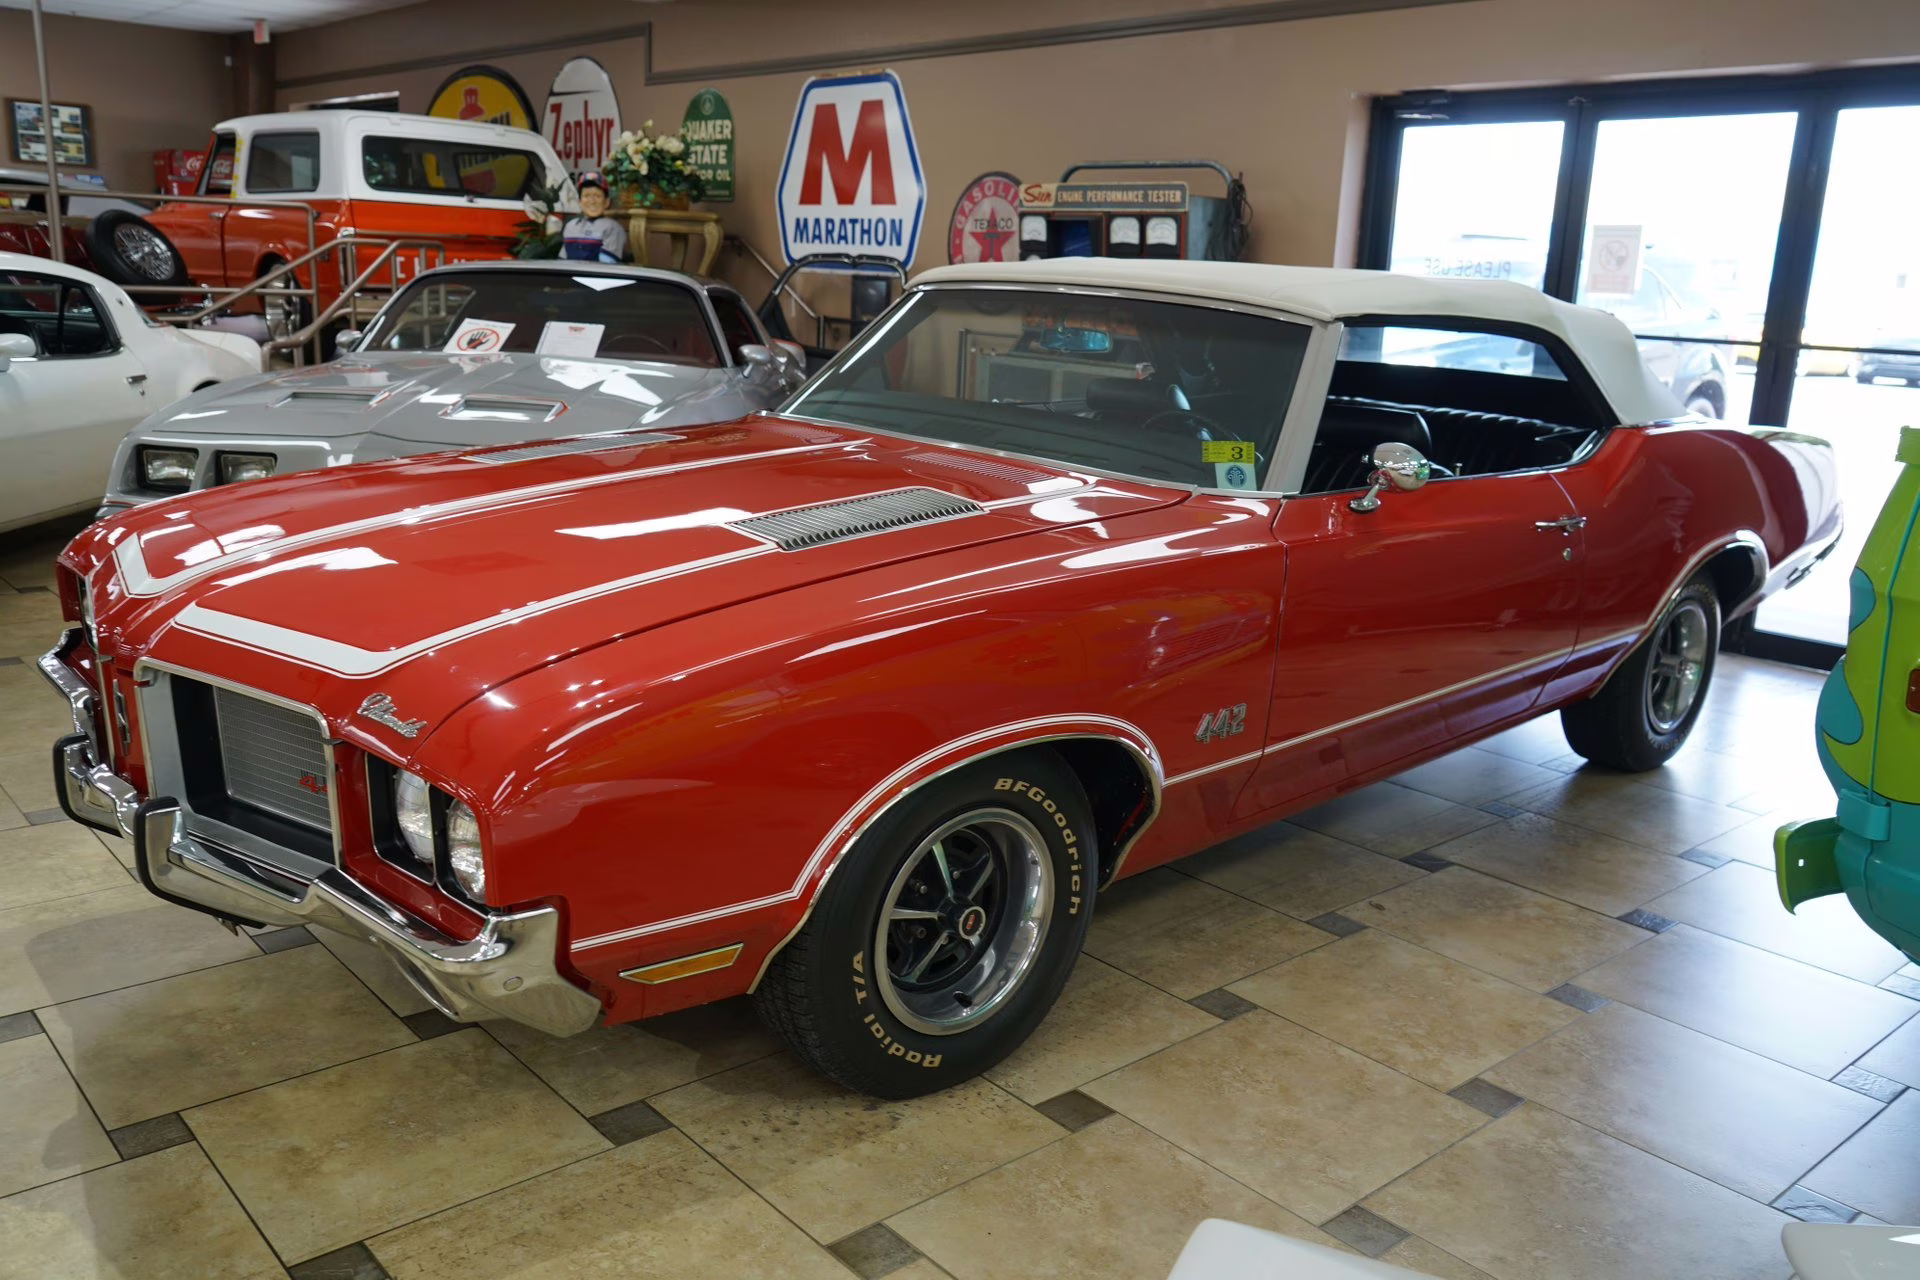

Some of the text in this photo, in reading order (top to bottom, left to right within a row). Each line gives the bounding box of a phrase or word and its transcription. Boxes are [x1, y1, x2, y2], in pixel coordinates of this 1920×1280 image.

[550, 100, 615, 168] Zephyr
[798, 99, 897, 205] M
[715, 169, 731, 181] OIL
[1023, 184, 1053, 204] Sun
[1057, 189, 1182, 203] ENGINE PERFORMANCE TESTER
[793, 217, 903, 246] MARATHON
[973, 217, 1014, 230] TEXACO
[1231, 446, 1244, 460] 3
[1193, 702, 1247, 744] 442
[994, 778, 1082, 914] BFGoodrich
[853, 951, 942, 1067] Radial T/A
